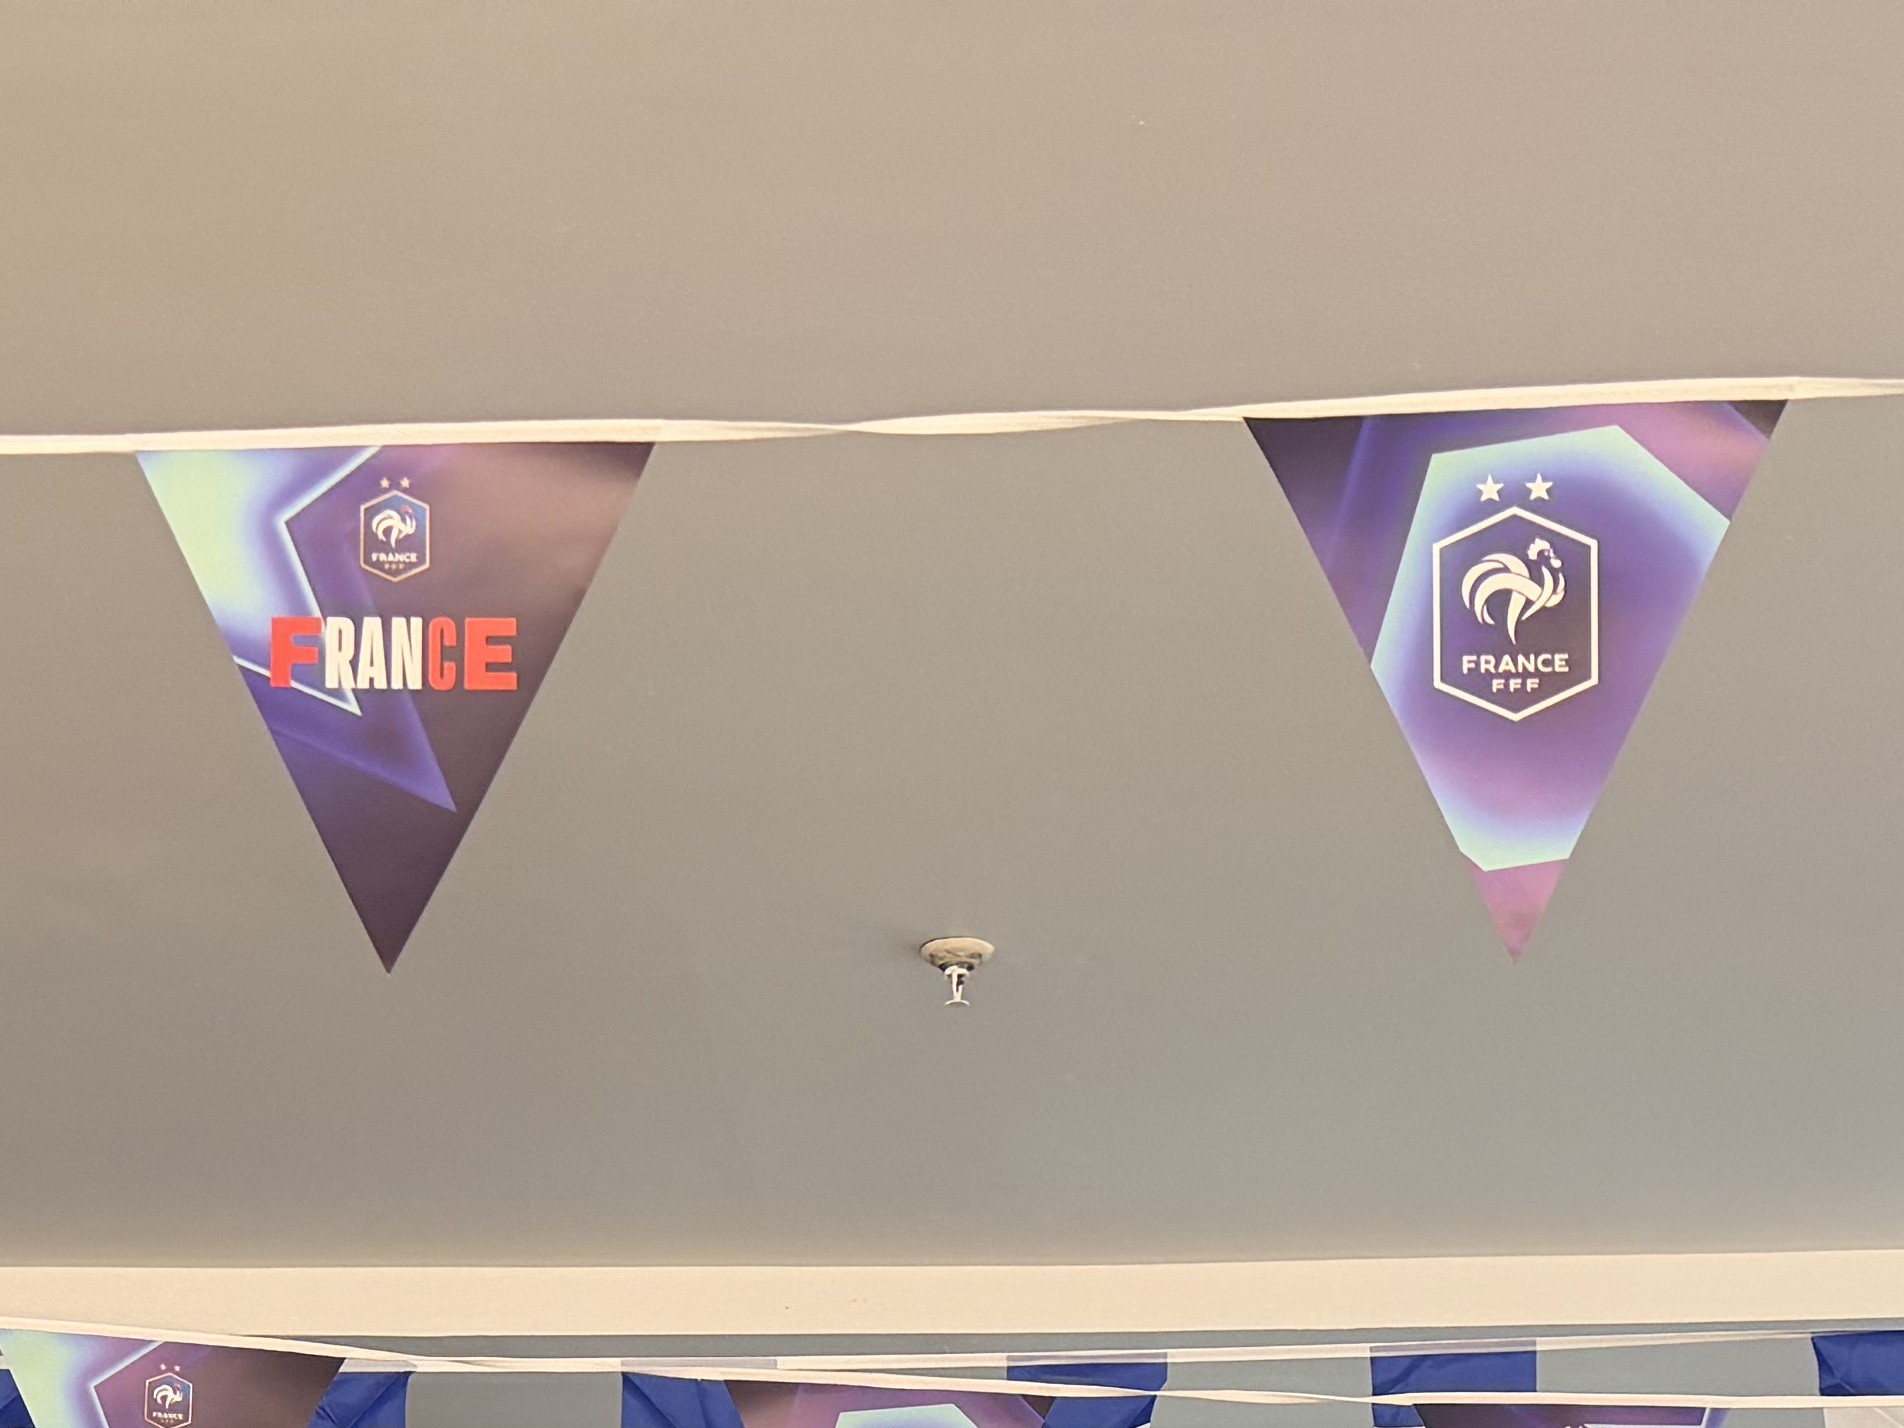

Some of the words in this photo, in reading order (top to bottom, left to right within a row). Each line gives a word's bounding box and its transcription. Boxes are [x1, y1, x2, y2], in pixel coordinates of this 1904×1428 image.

[371, 552, 417, 562] FRANCE
[270, 616, 518, 690] FRANCE
[1462, 654, 1569, 674] FRANCE
[1491, 678, 1539, 692] FFF
